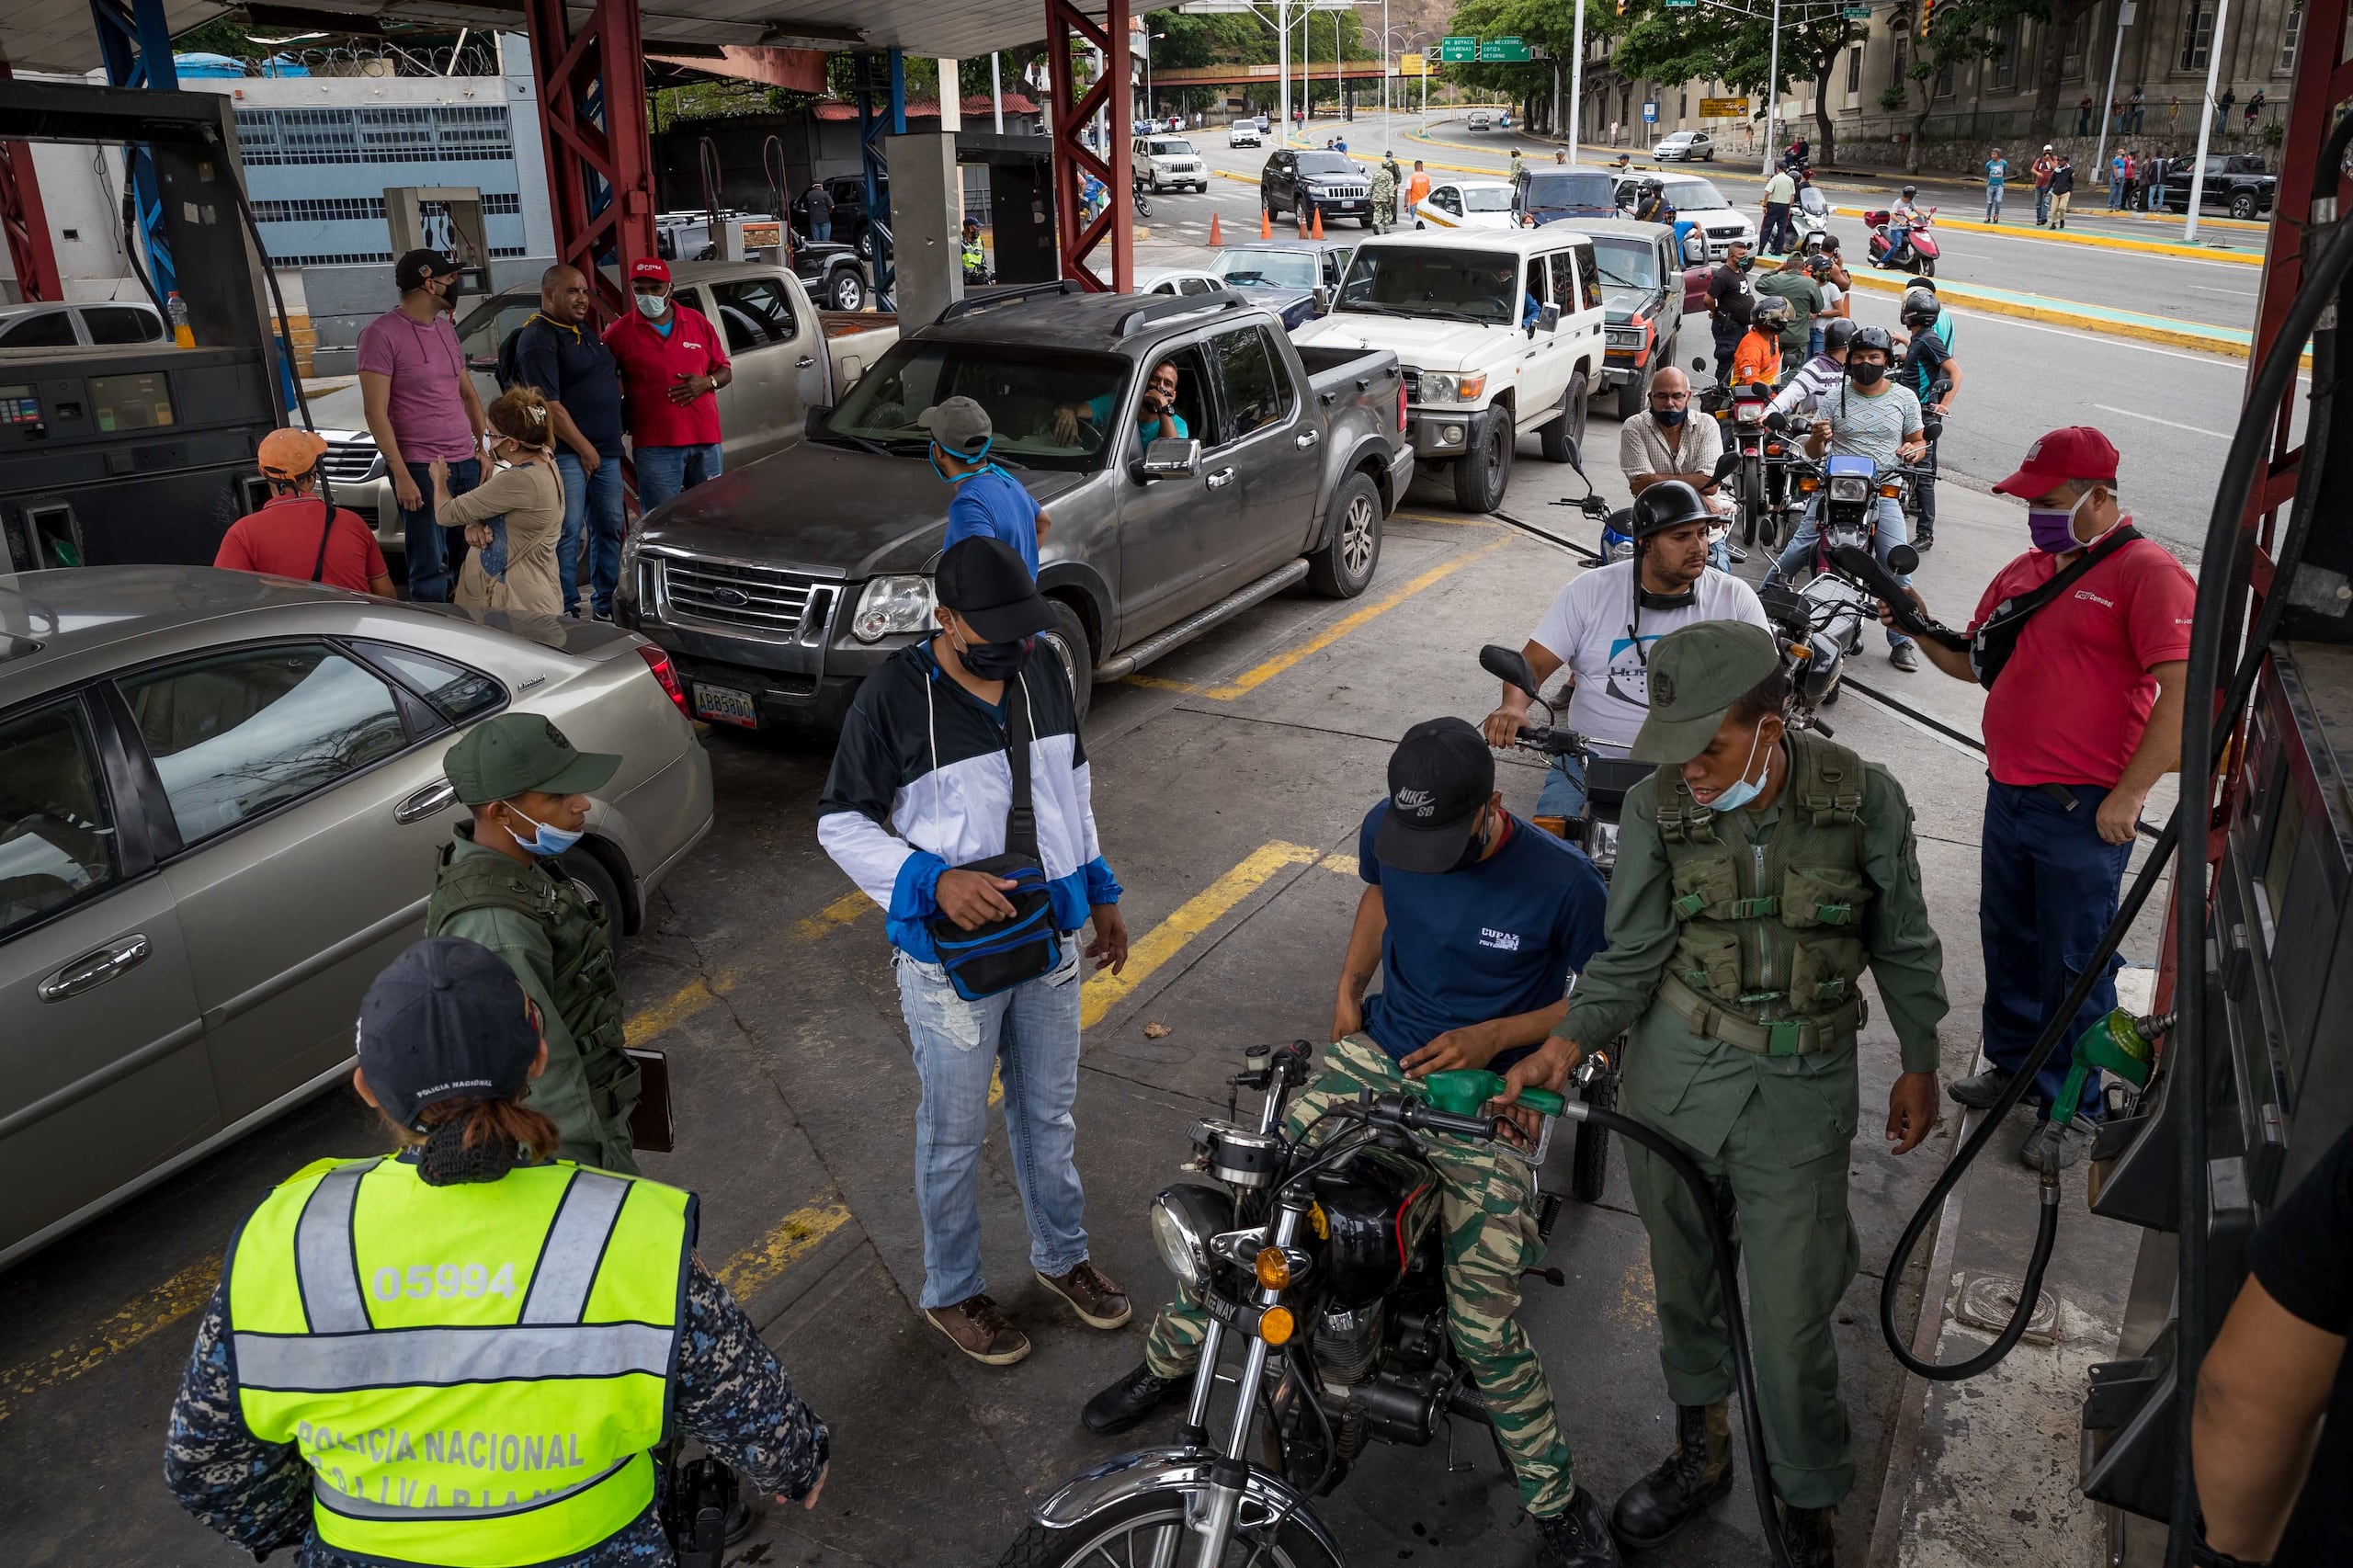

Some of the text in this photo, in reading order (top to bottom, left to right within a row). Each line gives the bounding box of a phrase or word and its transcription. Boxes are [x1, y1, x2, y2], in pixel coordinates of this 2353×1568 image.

[1398, 786, 1429, 805] NIKE
[1416, 805, 1435, 817] SB
[415, 1079, 493, 1098] POLICIA NACIONAL
[372, 1263, 516, 1301] 05994
[298, 1420, 585, 1472] POLICIA NACIONAL
